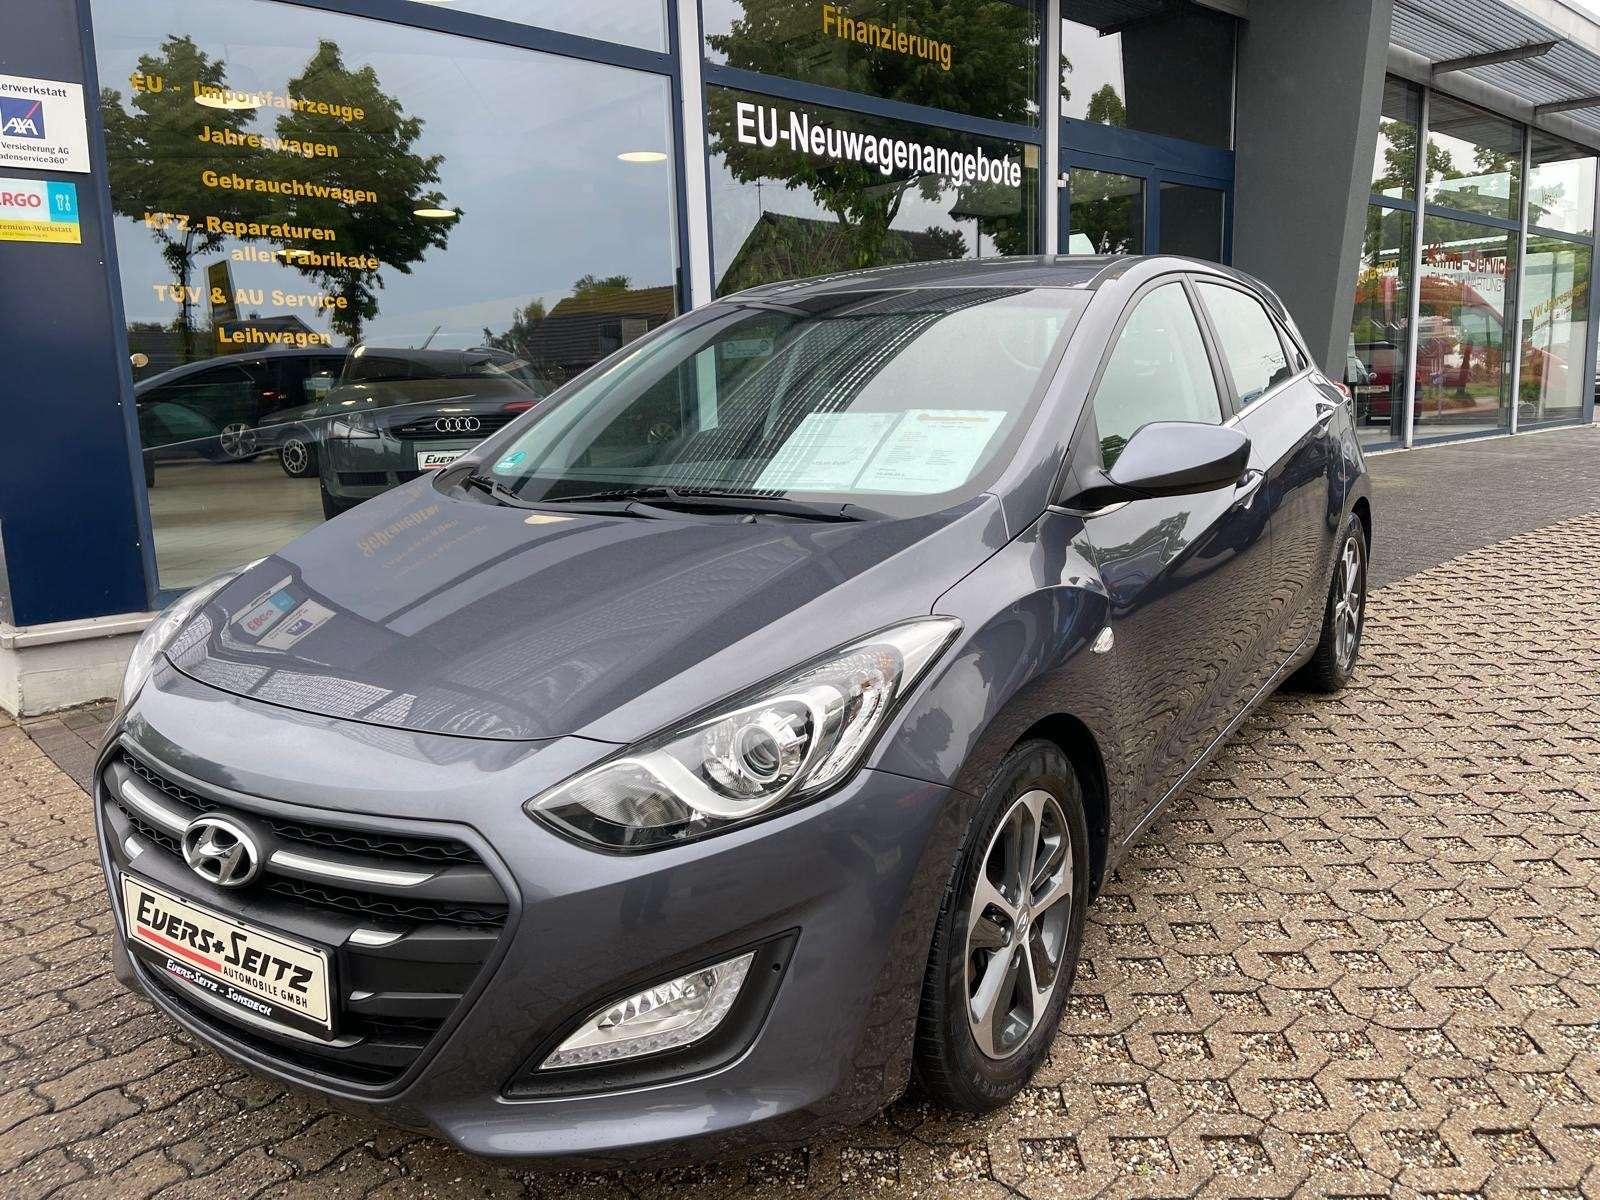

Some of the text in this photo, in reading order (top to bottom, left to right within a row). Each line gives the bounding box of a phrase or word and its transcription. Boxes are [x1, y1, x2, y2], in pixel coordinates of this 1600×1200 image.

[822, 4, 951, 70] Finanzierung
[0, 83, 67, 97] erwerkstatt
[130, 73, 163, 93] EU
[193, 81, 365, 121] Importfahrzeuge
[3, 117, 38, 135] AXA
[1, 141, 56, 154] Versicherung
[198, 126, 339, 158] Jahreswagen
[737, 102, 1021, 188] EU-Neuwagenangebote
[202, 171, 378, 203] Gebrauchtwagen
[0, 192, 42, 208] RGO
[144, 213, 190, 232] KFZ
[231, 246, 380, 270] aller Fabrikate
[153, 283, 348, 310] TÜV & AU Service
[219, 327, 332, 348] Leihwagen
[223, 966, 308, 1008] AUTOMOBILE GMBH
